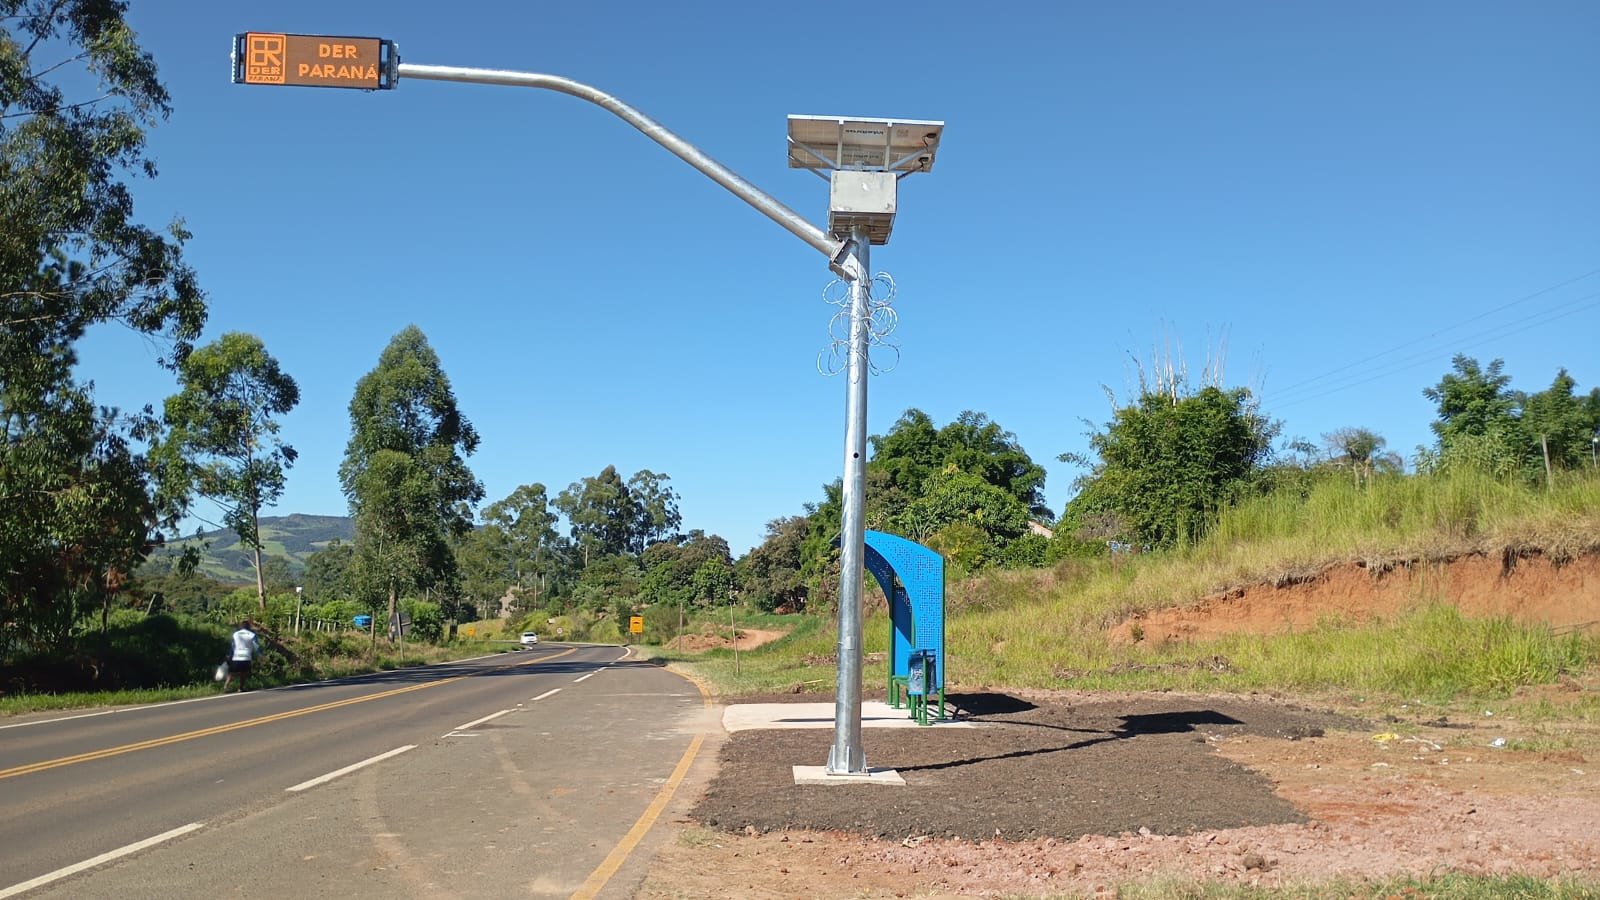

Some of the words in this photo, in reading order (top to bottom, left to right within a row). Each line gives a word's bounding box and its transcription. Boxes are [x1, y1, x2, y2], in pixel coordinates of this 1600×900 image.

[319, 43, 358, 59] DER
[250, 66, 281, 75] DER
[298, 63, 379, 80] PARANÁ
